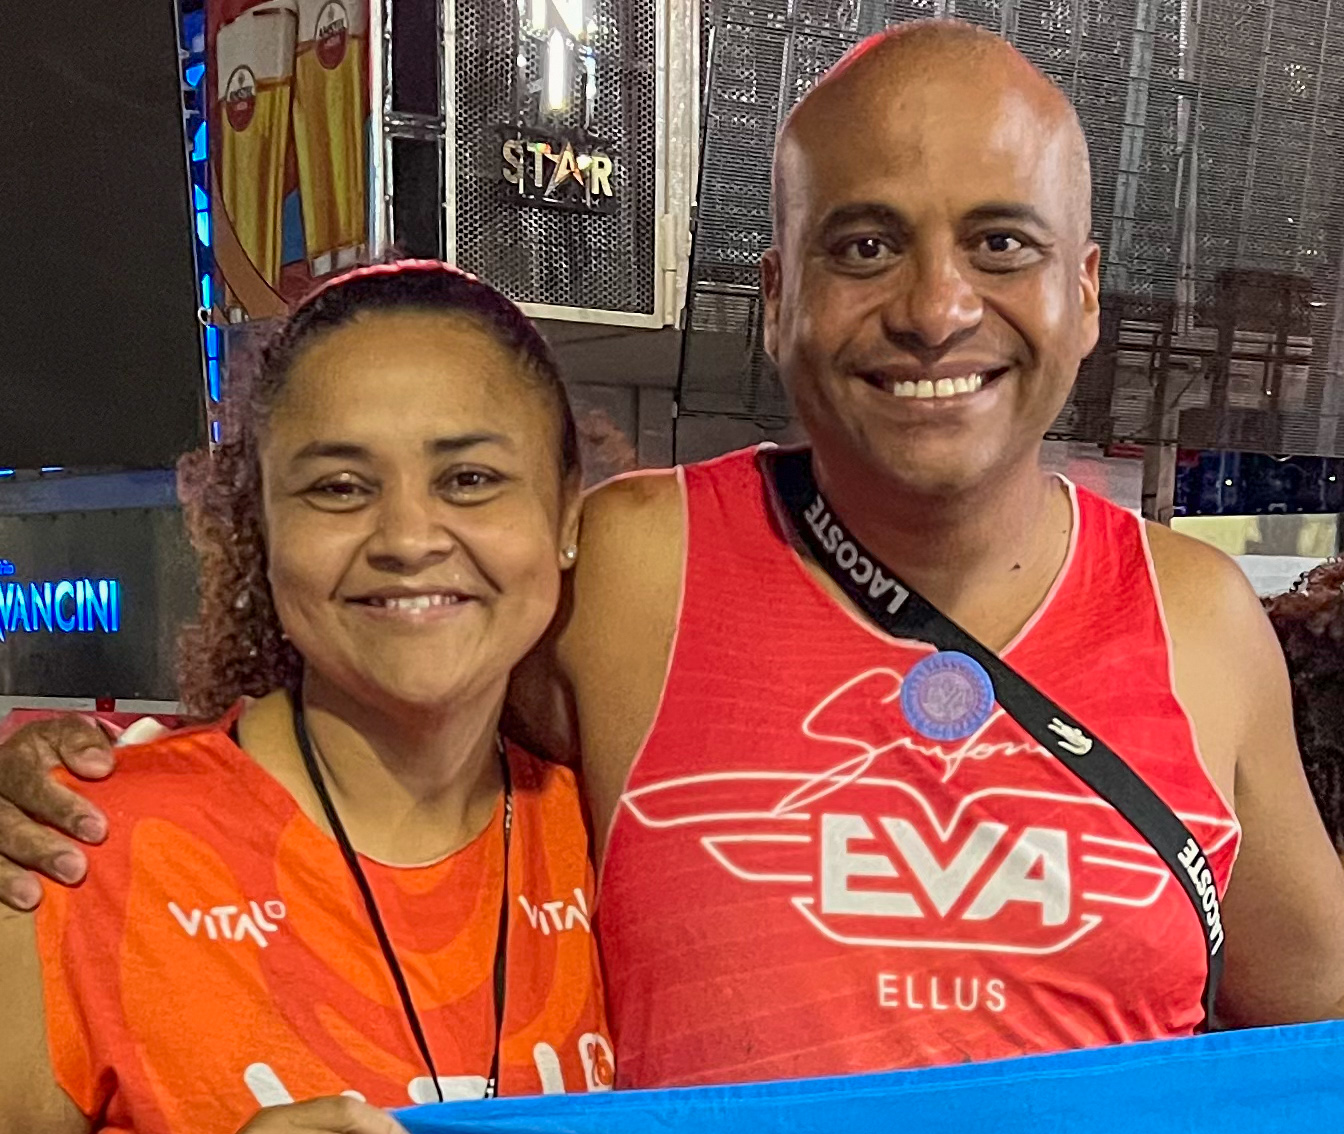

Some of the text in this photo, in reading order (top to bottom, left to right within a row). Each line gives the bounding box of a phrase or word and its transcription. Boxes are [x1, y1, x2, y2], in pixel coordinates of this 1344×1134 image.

[502, 139, 613, 197] STAR
[803, 494, 909, 614] LACOSTE
[821, 813, 1070, 926] EVA
[1177, 838, 1224, 956] LACOSTE
[878, 973, 1006, 1013] ELLUS
